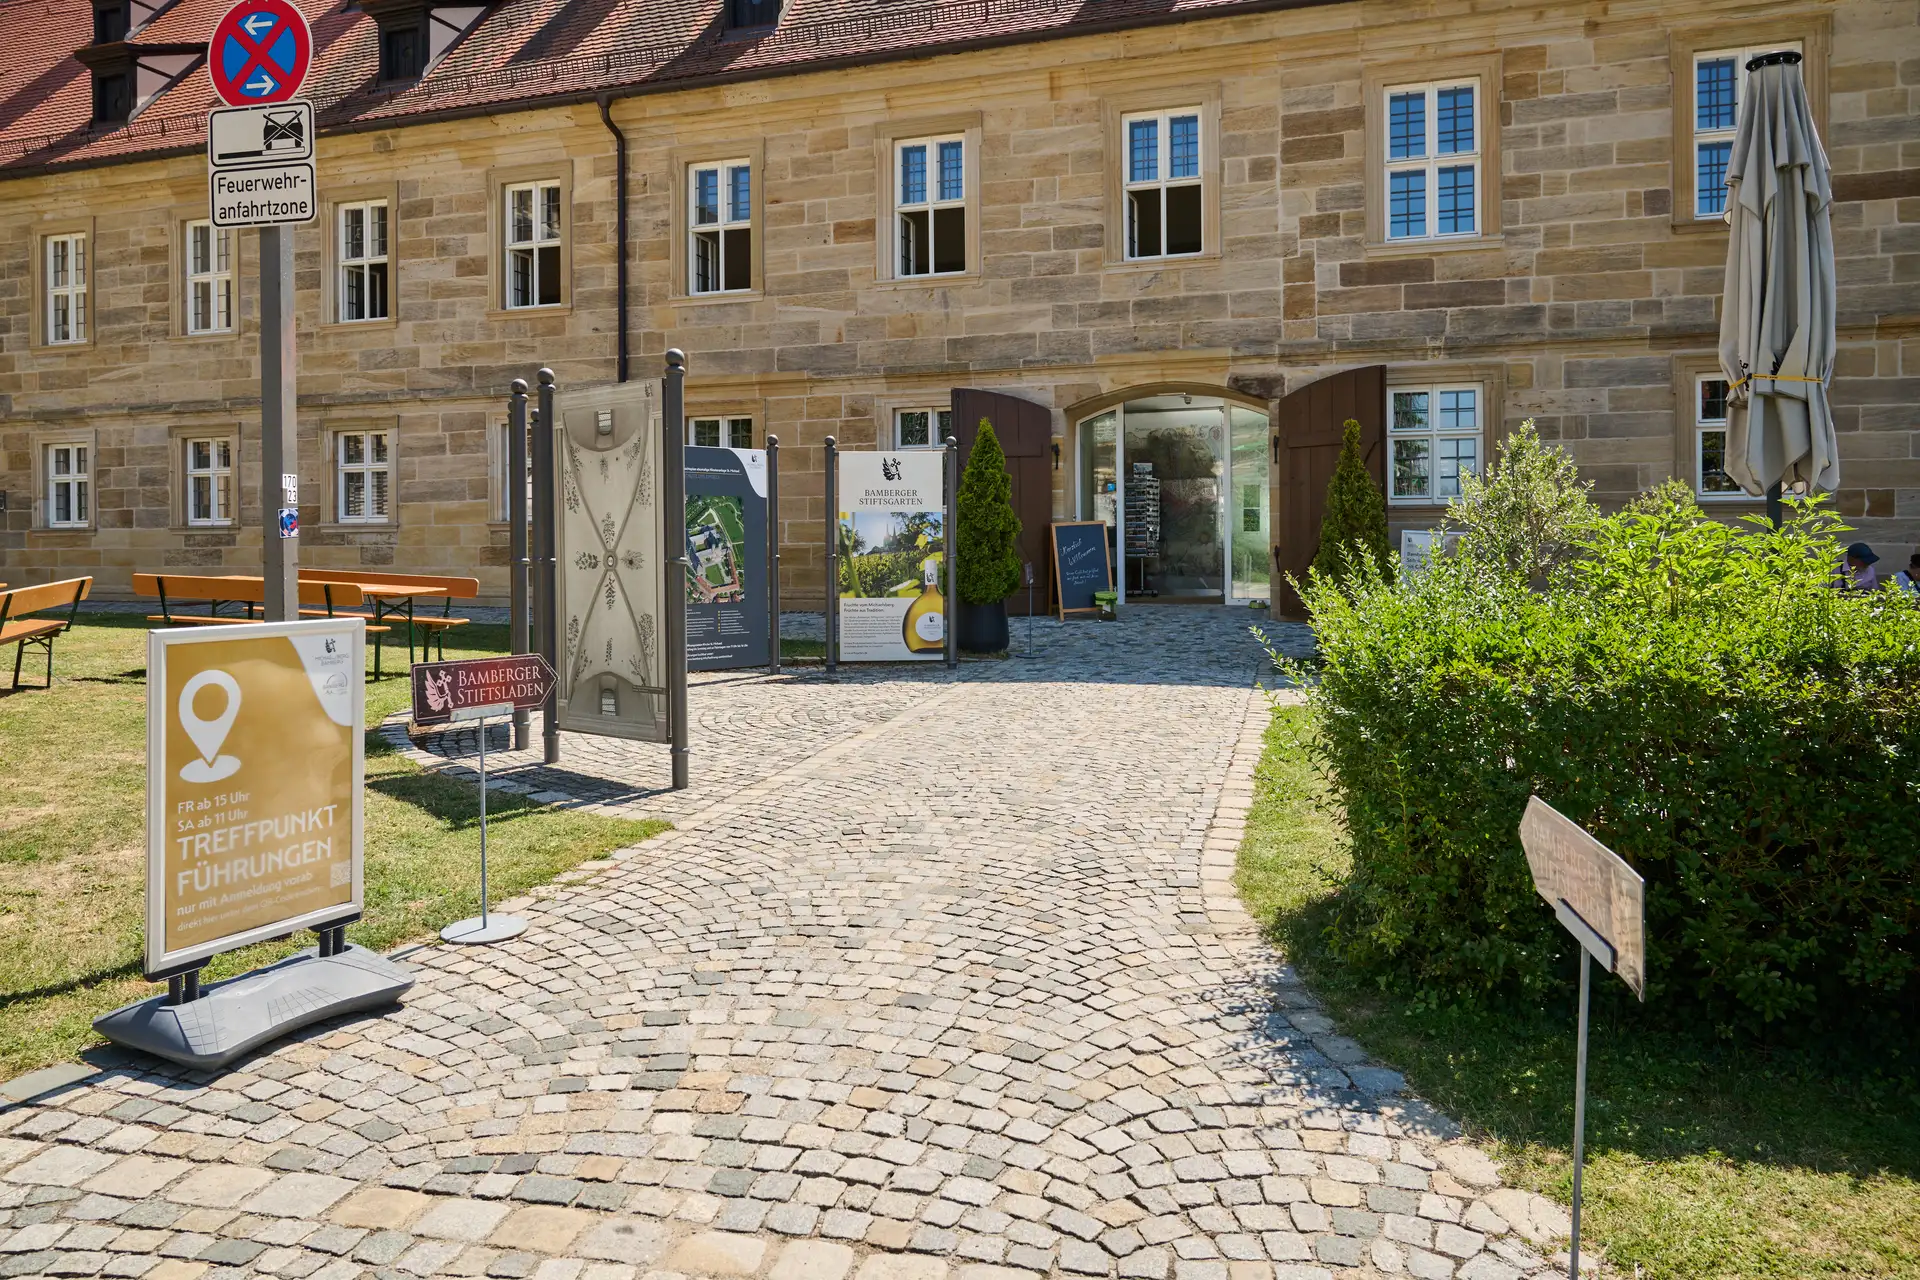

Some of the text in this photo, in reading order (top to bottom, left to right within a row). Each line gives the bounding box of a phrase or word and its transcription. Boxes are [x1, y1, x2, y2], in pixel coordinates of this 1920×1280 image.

[218, 172, 307, 194] Feuerwehr-
[219, 200, 308, 220] anfahrtzone
[284, 475, 296, 488] 170
[864, 489, 918, 497] BAMBERGER
[288, 490, 296, 502] 23
[458, 665, 541, 687] BAMBERGER
[457, 682, 544, 705] STIFTSLADEN
[177, 791, 250, 814] FR ab 15 Uhr
[177, 808, 248, 832] SA ab 11 Uhr
[176, 804, 338, 861] TREFFPUNKT
[177, 837, 332, 897] FÜHRUNGEN
[1531, 814, 1605, 897] BAMBERGER
[176, 903, 195, 916] nur
[199, 896, 217, 909] mit
[220, 880, 282, 905] Anmeldung
[284, 872, 313, 886] vorab
